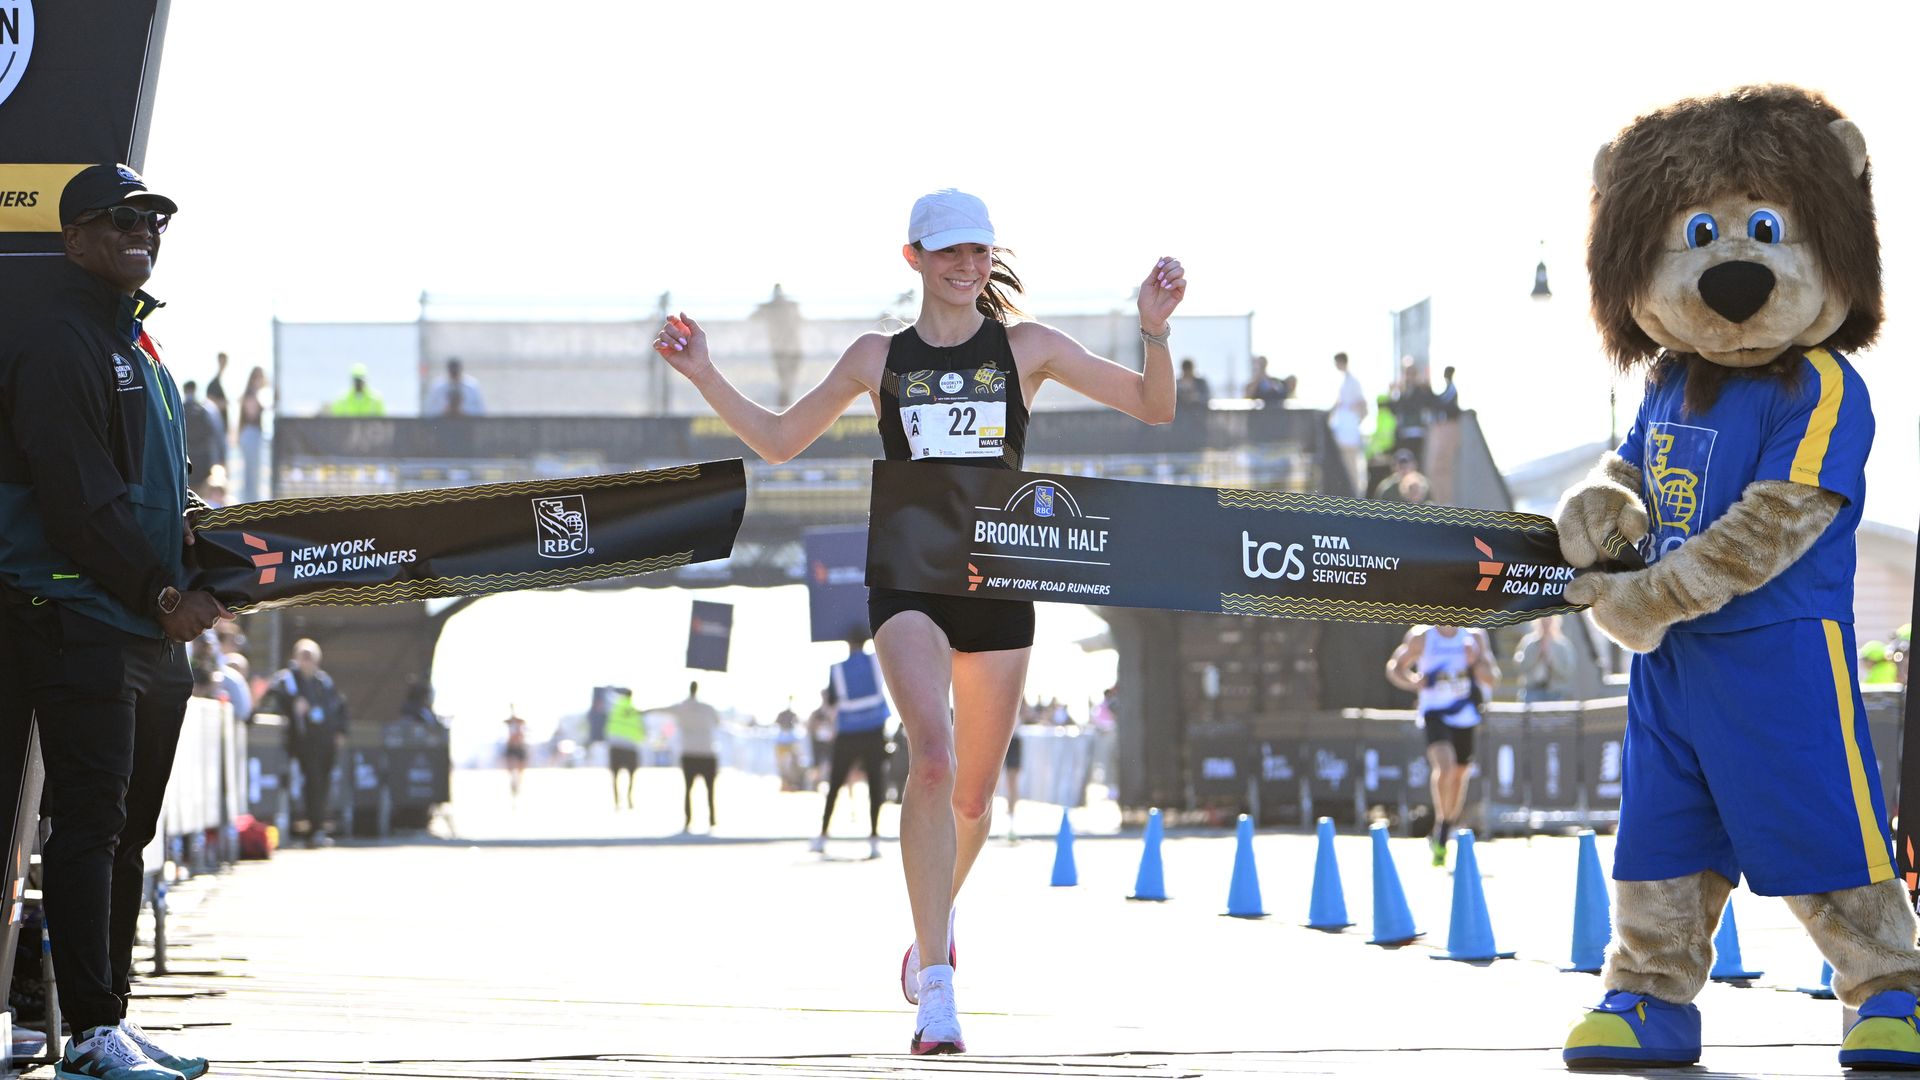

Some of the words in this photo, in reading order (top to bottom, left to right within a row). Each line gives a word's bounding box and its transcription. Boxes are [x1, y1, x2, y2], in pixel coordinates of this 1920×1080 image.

[948, 407, 977, 436] 22
[984, 428, 999, 436] VIP
[1036, 507, 1051, 515] RBC
[974, 520, 1060, 549] BROOKLYN
[1068, 528, 1109, 552] HALF
[1312, 535, 1350, 550] TATA
[290, 544, 328, 563] NEW
[330, 538, 376, 557] YORK
[544, 537, 582, 553] RBC
[293, 561, 338, 579] ROAD
[342, 549, 417, 572] RUNNERS
[1242, 530, 1305, 581] tcs
[1312, 552, 1400, 571] CONSULTANCY
[1312, 569, 1367, 585] SERVICES
[1505, 563, 1538, 578] NEW
[1538, 565, 1577, 580] YORK
[986, 577, 1012, 588] NEW
[1012, 579, 1039, 590] YORK
[1039, 580, 1066, 592] ROAD
[1067, 582, 1111, 595] RUNNERS
[1502, 580, 1540, 595] ROAD
[1542, 583, 1567, 596] RU
